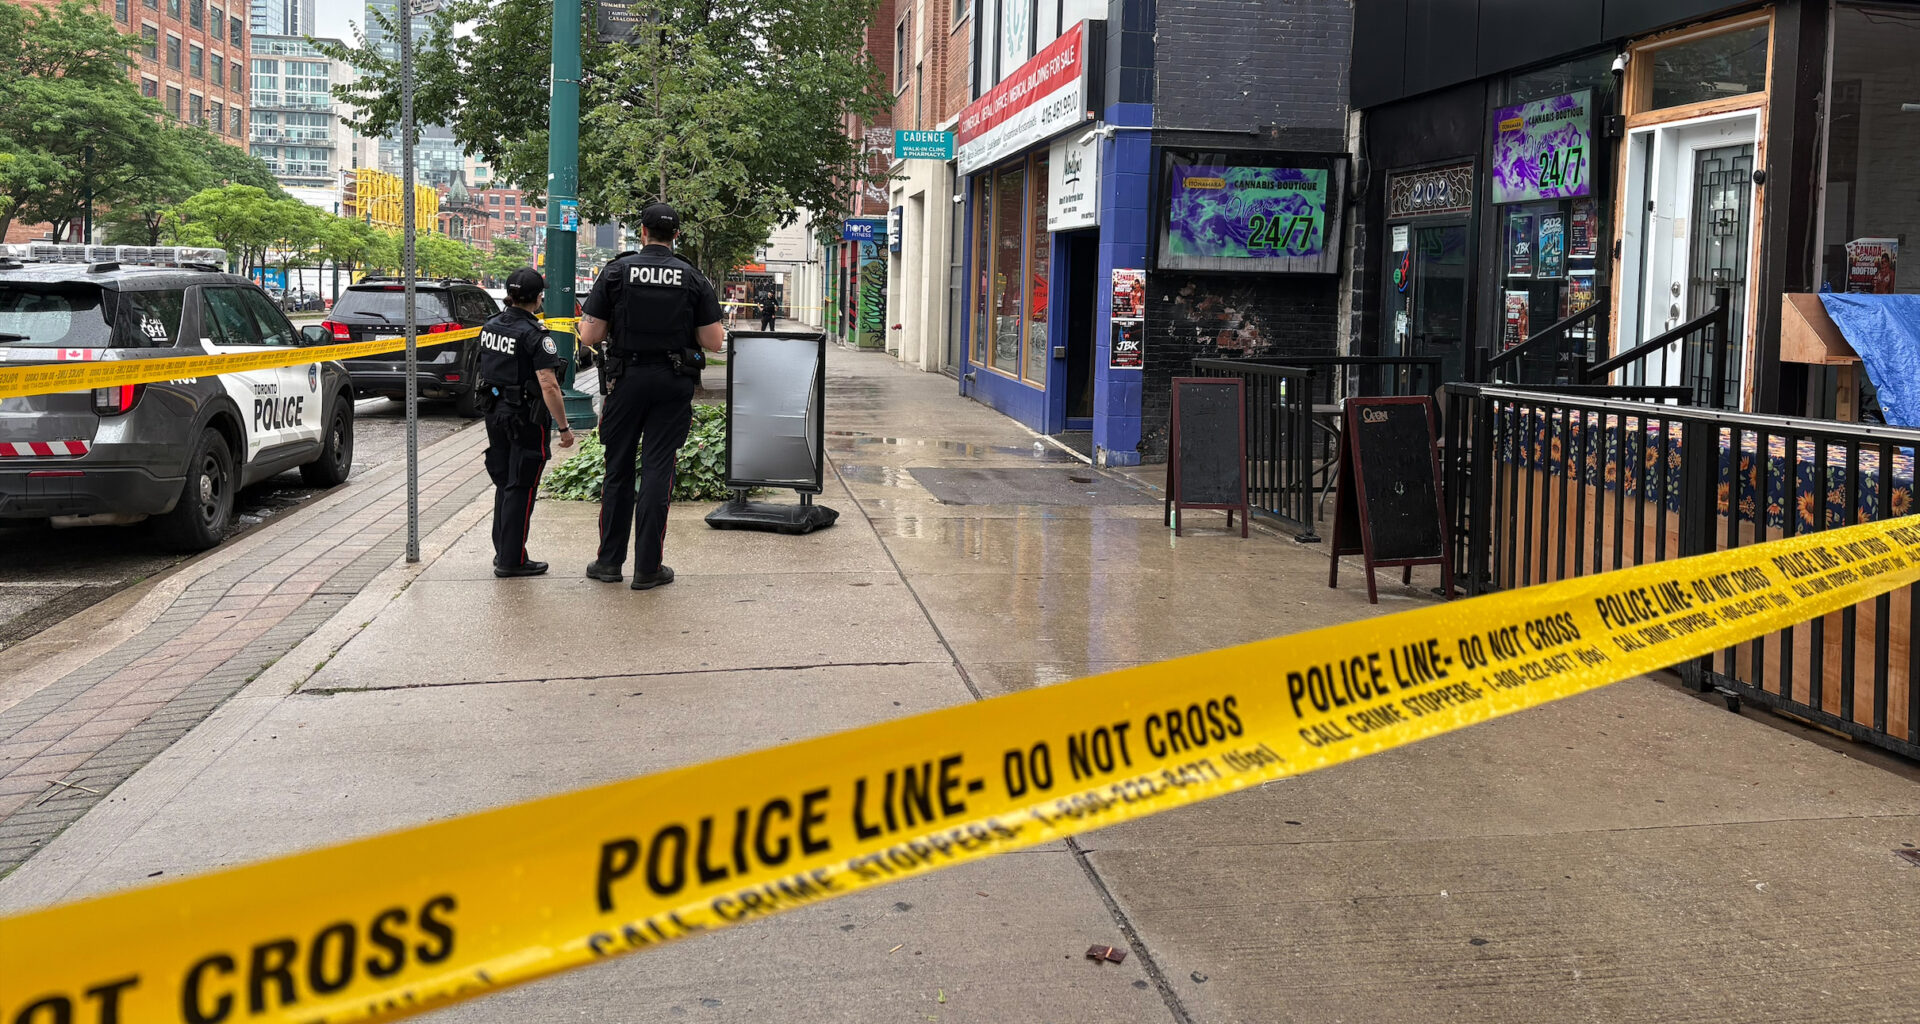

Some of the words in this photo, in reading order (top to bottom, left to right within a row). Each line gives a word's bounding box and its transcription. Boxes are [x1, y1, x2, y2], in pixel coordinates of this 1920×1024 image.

[1049, 55, 1062, 78] FOR
[1060, 45, 1075, 70] SALE
[1528, 112, 1555, 125] CANNABIS
[1555, 106, 1584, 120] BOUTIQUE
[903, 132, 945, 143] CADENCE
[1539, 147, 1582, 188] 24/7
[1234, 180, 1275, 190] CANNABIS
[1277, 180, 1317, 191] BOUTIQUE
[1414, 180, 1449, 203] 202
[1249, 215, 1314, 249] 24/7
[1543, 217, 1562, 228] 202
[1514, 241, 1530, 255] JBK
[1855, 245, 1882, 257] CANADA
[629, 266, 682, 286] POLICE
[1851, 266, 1878, 275] ROOFTOP
[480, 330, 516, 355] POLICE
[1116, 340, 1140, 351] JBK
[254, 383, 278, 396] TORONTO
[254, 396, 304, 432] POLICE
[1771, 550, 1820, 580] POLICE
[1806, 546, 1841, 570] LINE-
[1833, 546, 1856, 563] DO
[1845, 542, 1869, 560] NOT
[1859, 536, 1892, 556] CROSS
[1595, 587, 1660, 630] POLICE
[1650, 579, 1693, 615] LINE-
[1689, 578, 1716, 604] DO
[1708, 573, 1738, 599] NOT
[1731, 566, 1772, 594] CROSS
[1612, 632, 1646, 653] CALL
[1637, 623, 1677, 646] CRIME
[1286, 652, 1391, 719] POLICE
[1390, 637, 1453, 689] LINE-
[1458, 634, 1489, 671] DO
[1487, 624, 1525, 662] NOT
[1525, 611, 1582, 652] CROSS
[1298, 721, 1353, 749] CALL
[1346, 703, 1409, 733] CRIME
[1482, 652, 1578, 693] 1-800-222-8477
[595, 785, 832, 914] POLICE
[852, 754, 984, 841] LINE-
[1003, 740, 1054, 799] DO
[1068, 721, 1132, 782] NOT
[1145, 695, 1243, 759] CROSS
[708, 867, 846, 922] CRIME
[180, 894, 460, 1024] CROSS
